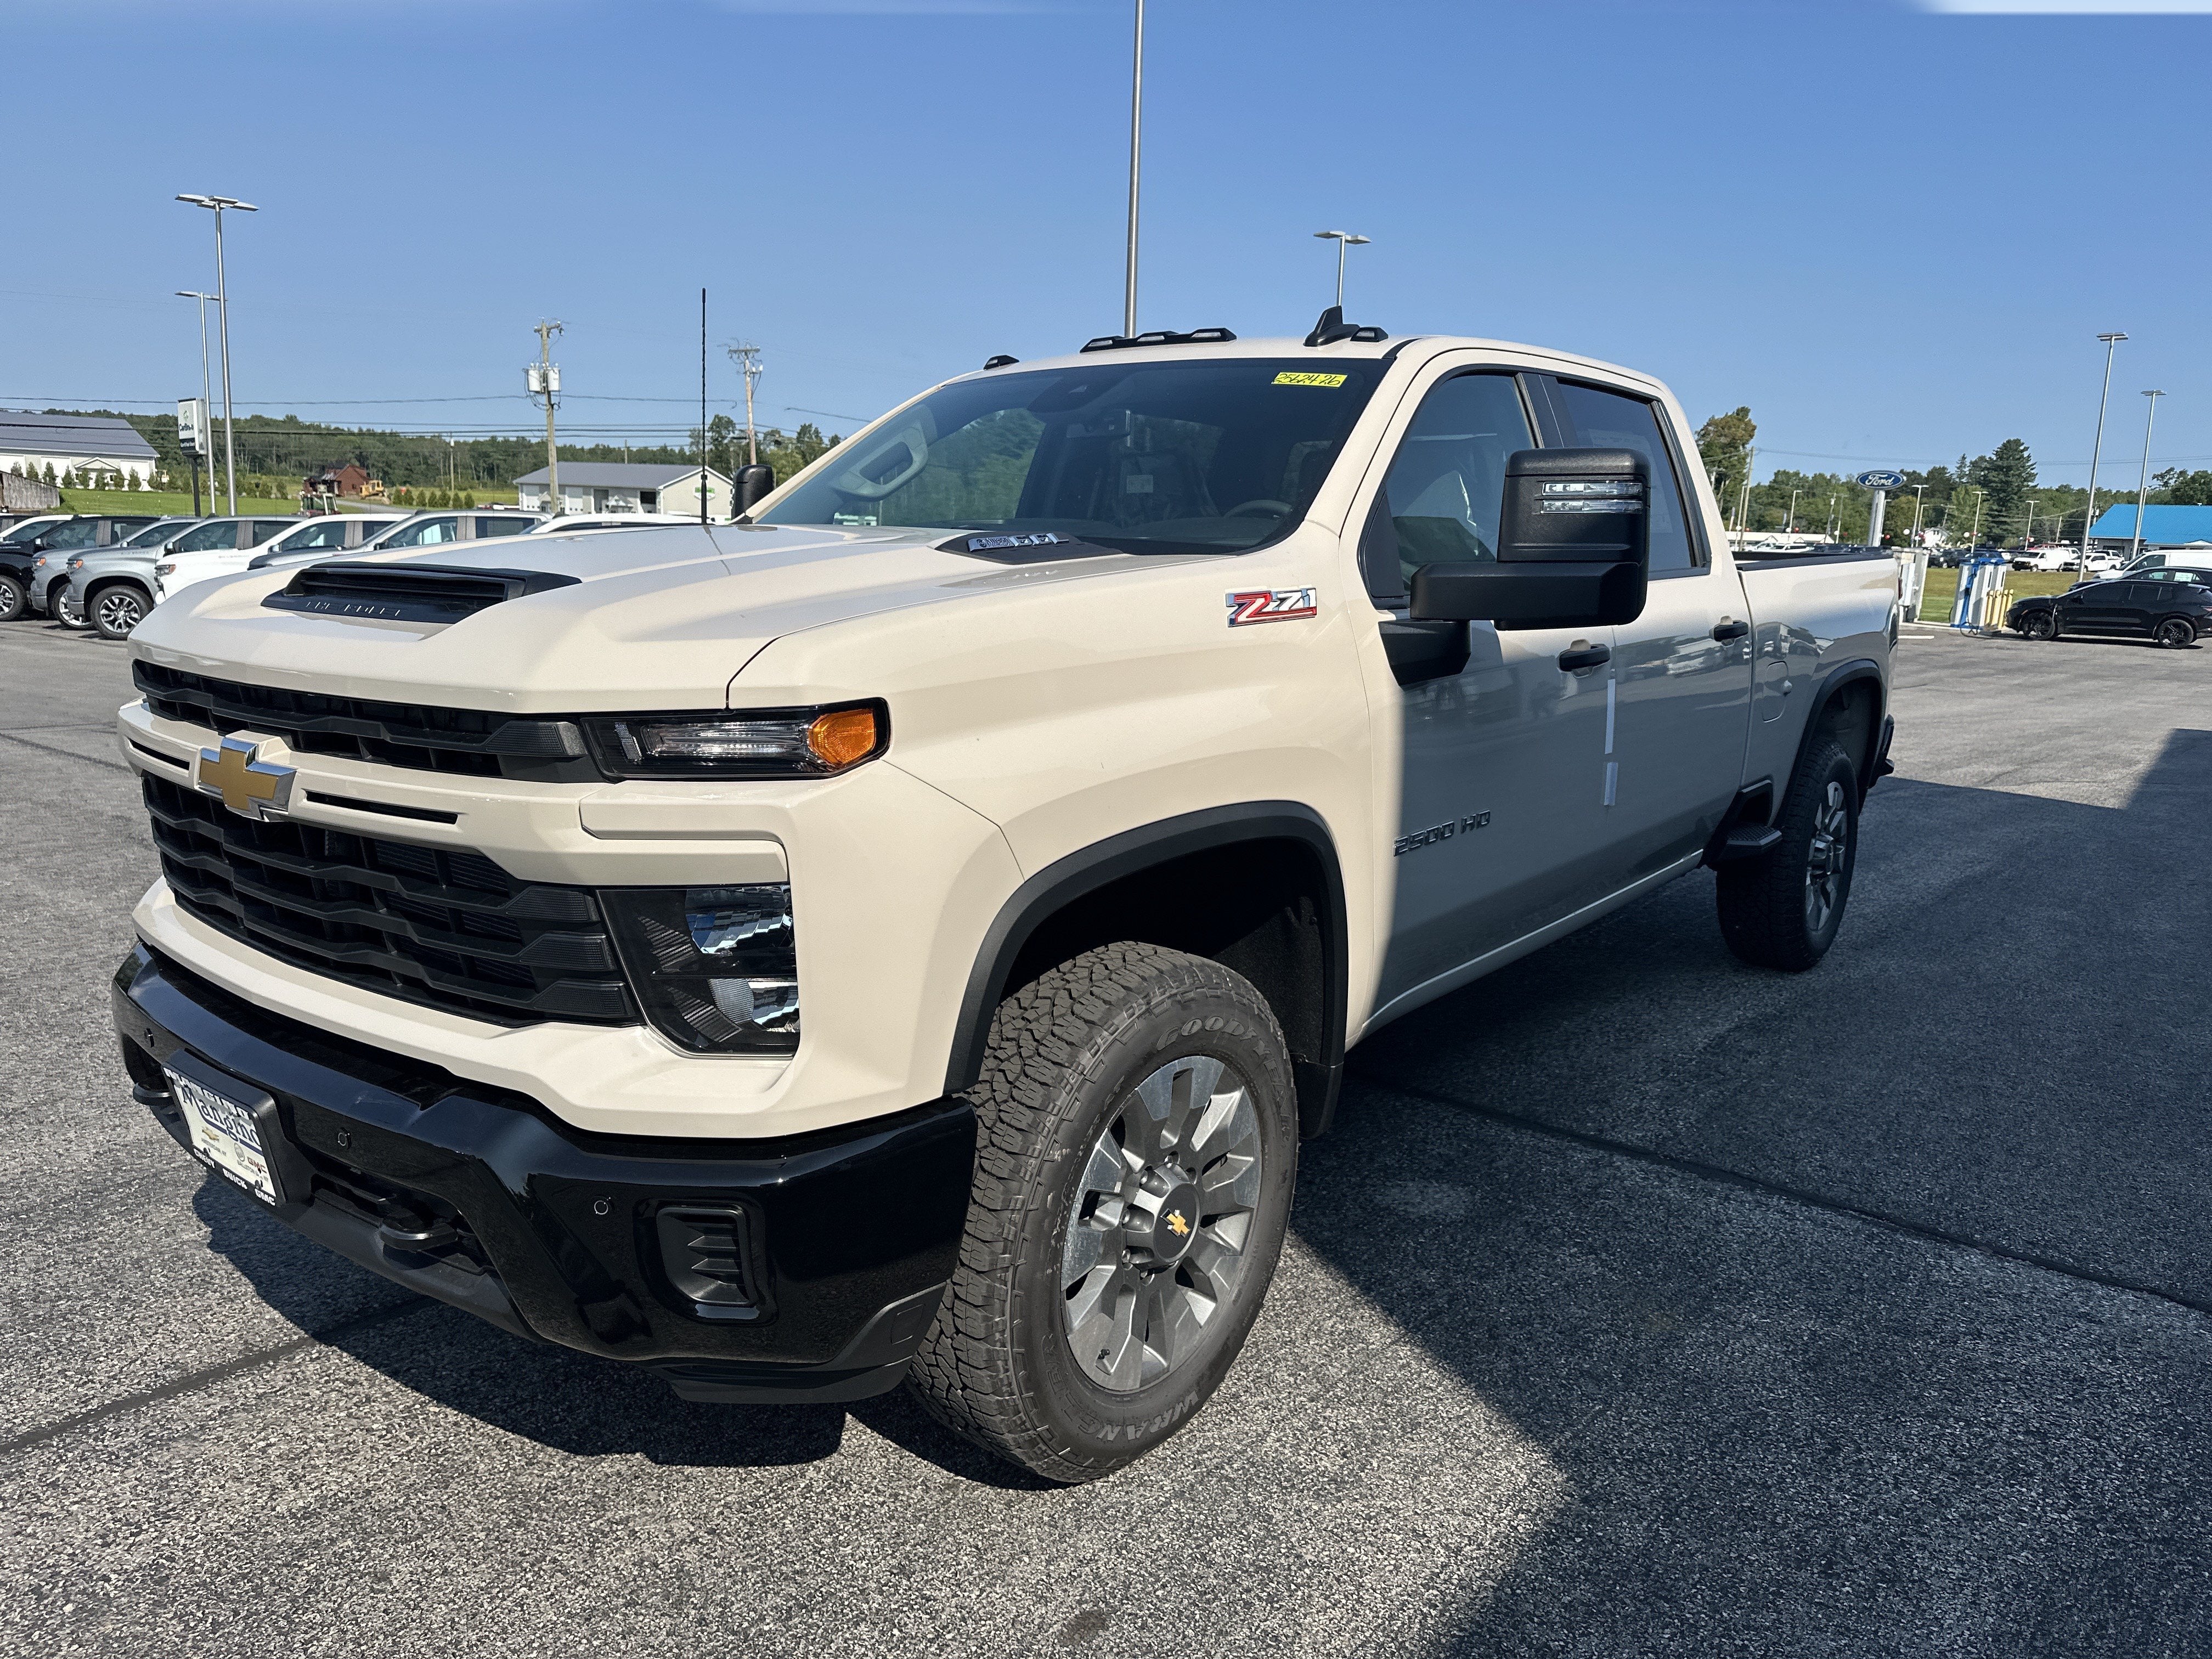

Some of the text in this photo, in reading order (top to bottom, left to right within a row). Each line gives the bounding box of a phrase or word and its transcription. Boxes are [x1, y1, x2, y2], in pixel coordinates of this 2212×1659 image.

[1865, 473, 1895, 486] Ford
[1226, 587, 1317, 627] Z71
[1393, 809, 1491, 857] 2500 HD
[1156, 1016, 1291, 1144] GOODYEAR
[181, 1086, 261, 1146] Mangino
[247, 1156, 267, 1174] GMC
[255, 1188, 276, 1206] GMC
[1041, 1333, 1199, 1442] WRANGLER
